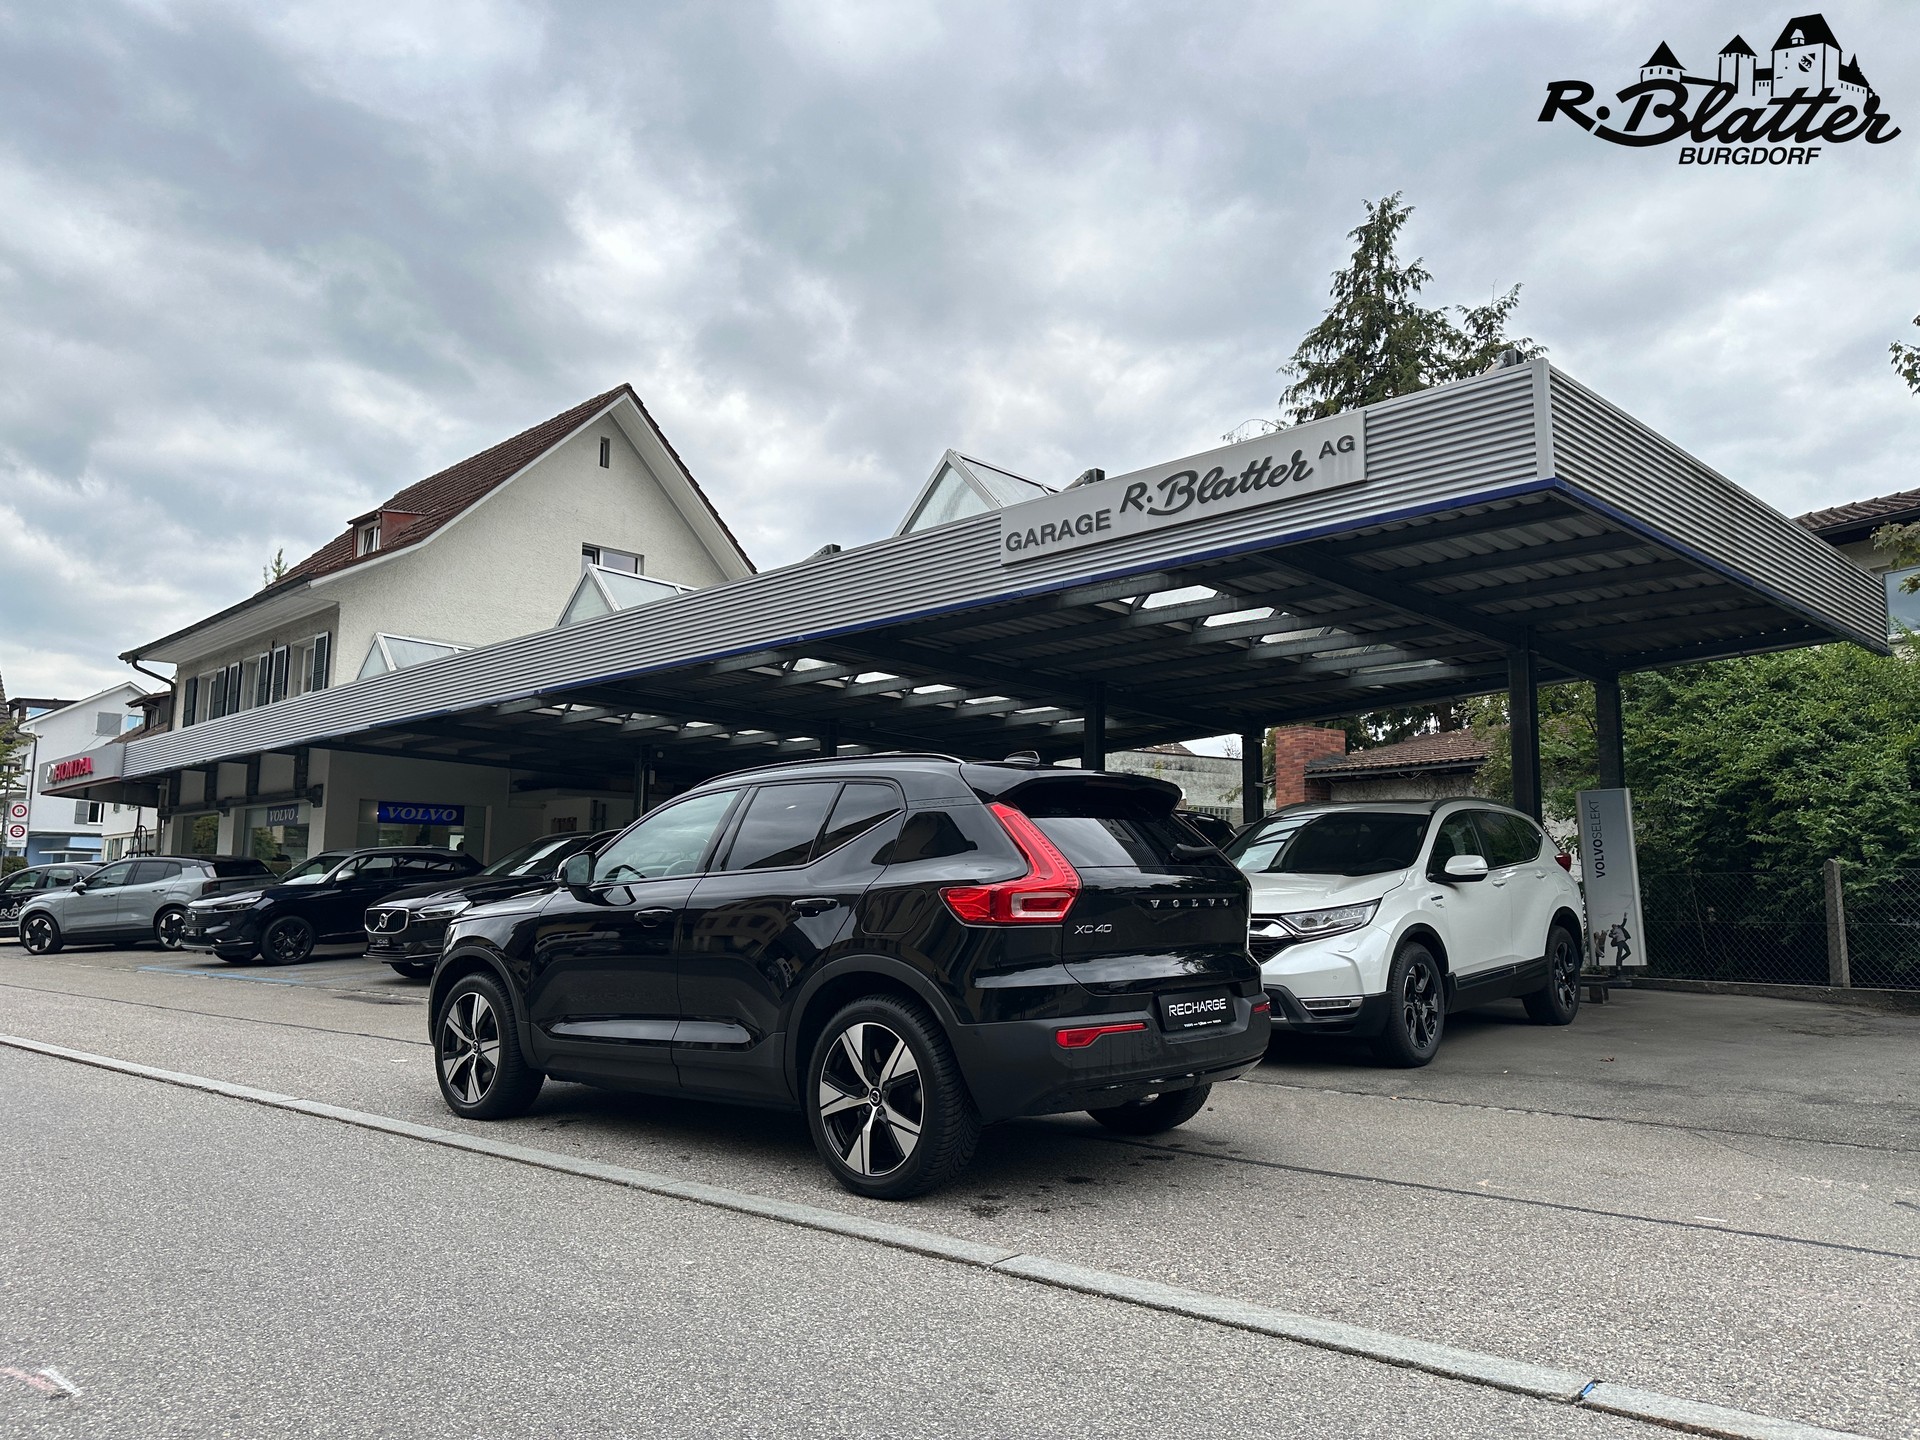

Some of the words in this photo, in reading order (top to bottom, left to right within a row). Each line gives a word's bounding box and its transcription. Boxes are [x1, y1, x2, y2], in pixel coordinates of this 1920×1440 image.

[1005, 508, 1111, 552] GARAGE
[1318, 434, 1355, 460] AG
[54, 757, 93, 781] HONDA
[269, 808, 295, 822] VOLVO
[387, 806, 458, 821] VOLVO
[1150, 899, 1229, 909] VOLVO
[1074, 923, 1113, 935] XC40
[1168, 998, 1227, 1017] RECHARGE
